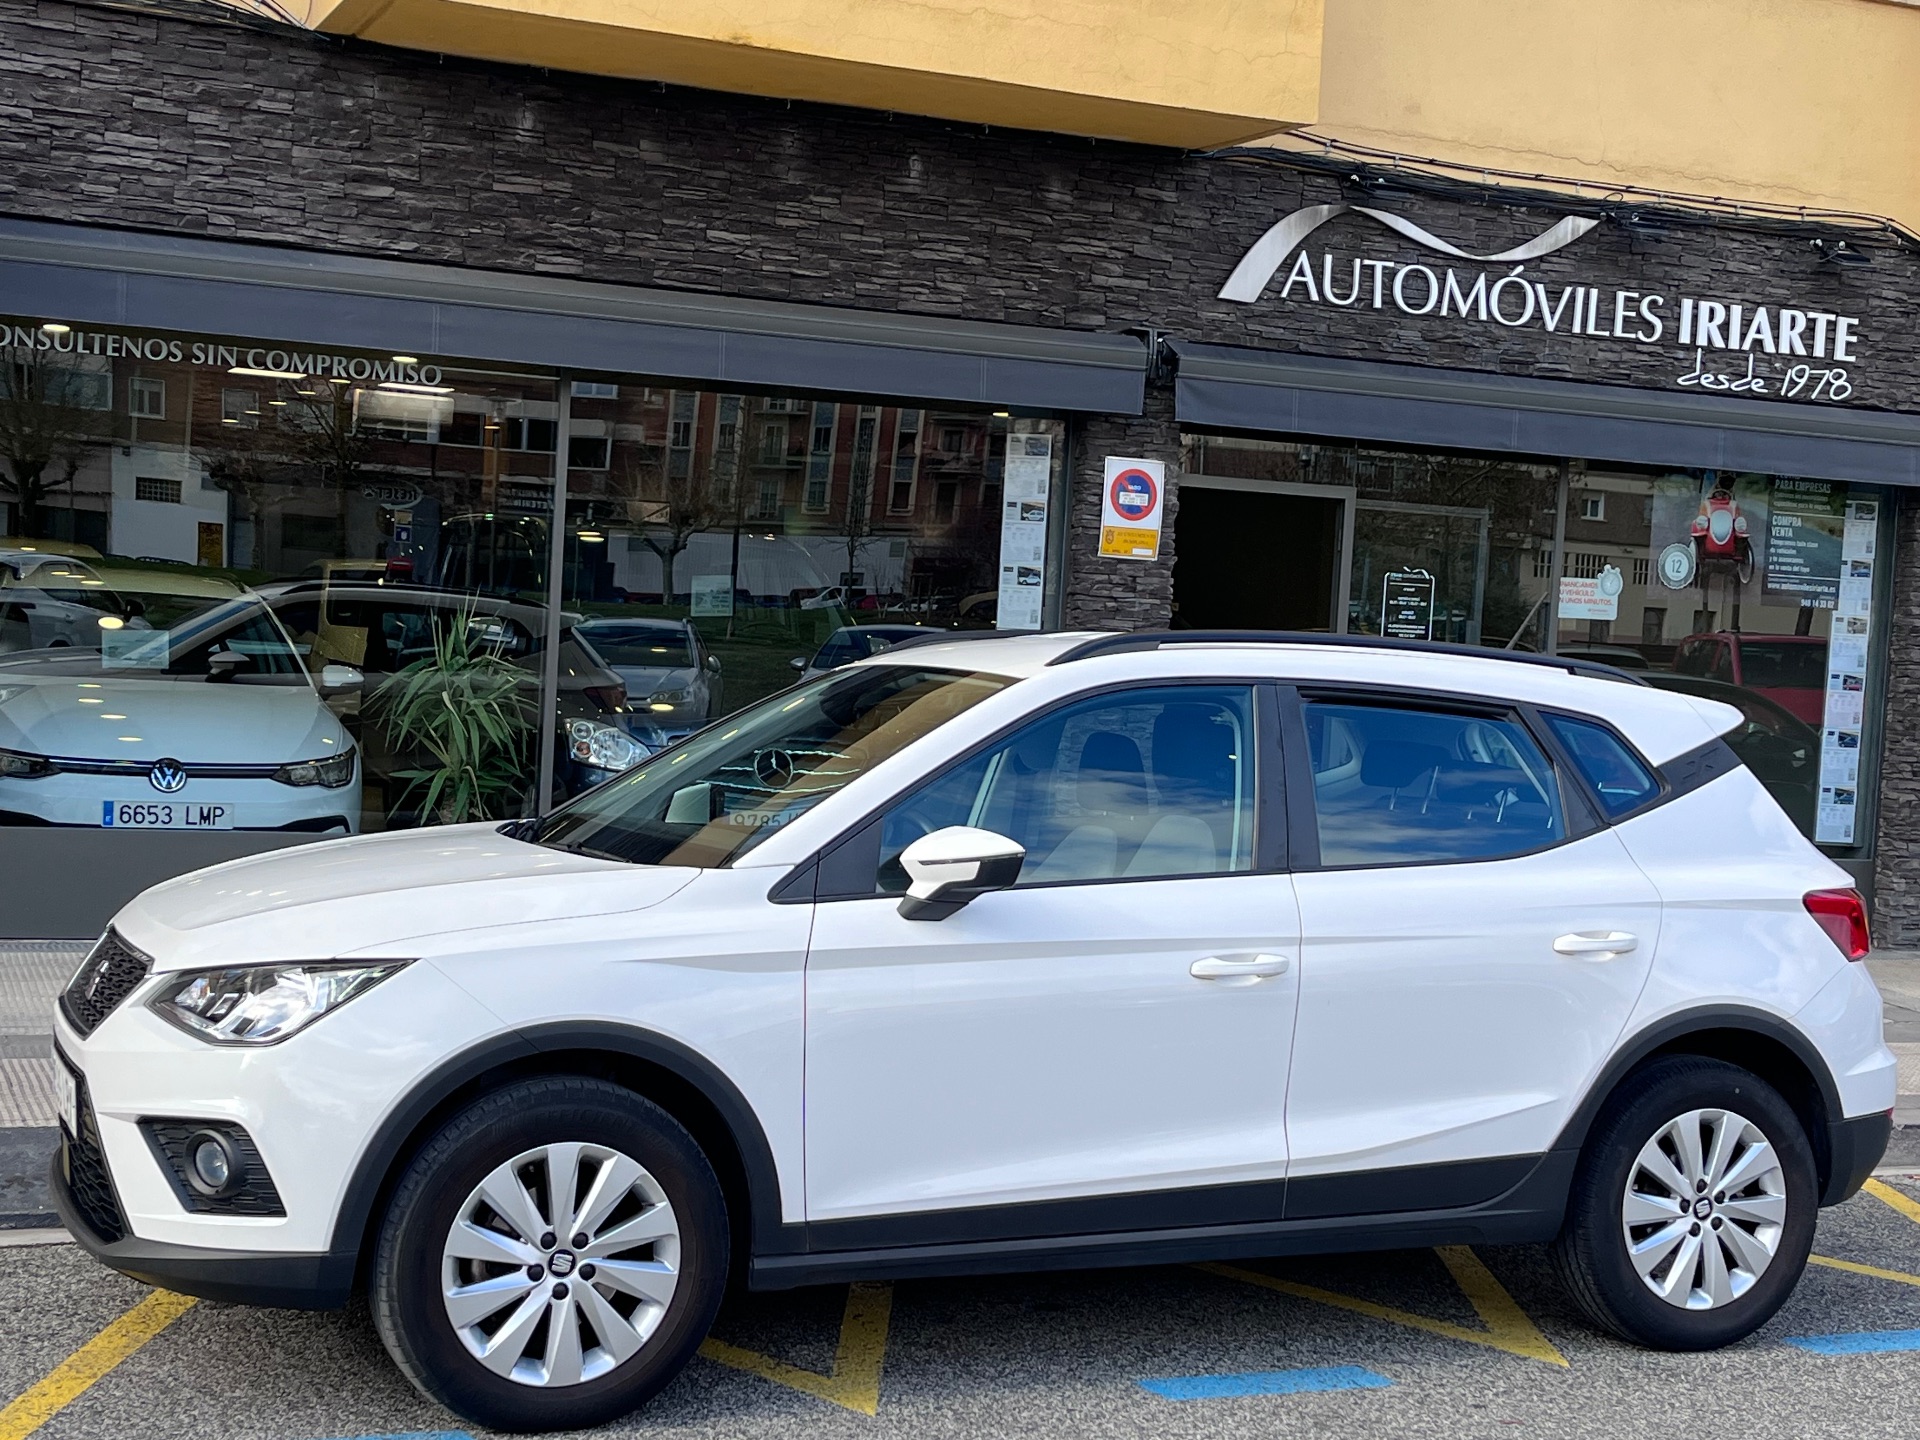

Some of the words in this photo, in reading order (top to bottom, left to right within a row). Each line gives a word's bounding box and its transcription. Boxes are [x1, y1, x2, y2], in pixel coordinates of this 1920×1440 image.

[1279, 249, 1665, 343] AUTOMÓVILES
[1677, 298, 1860, 363] IRIARTE
[191, 342, 237, 367] SIN
[246, 348, 443, 386] COMPROMISO
[1676, 347, 1769, 393] desde
[1780, 364, 1852, 400] 1978
[1774, 479, 1793, 490] PARA
[1795, 481, 1832, 494] EMPRESAS
[1772, 515, 1802, 528] COMPRA
[1771, 526, 1793, 537] VENTA
[1672, 560, 1682, 573] 12
[119, 804, 173, 825] 6653
[185, 805, 225, 826] LMP
[734, 813, 781, 827] 9785
